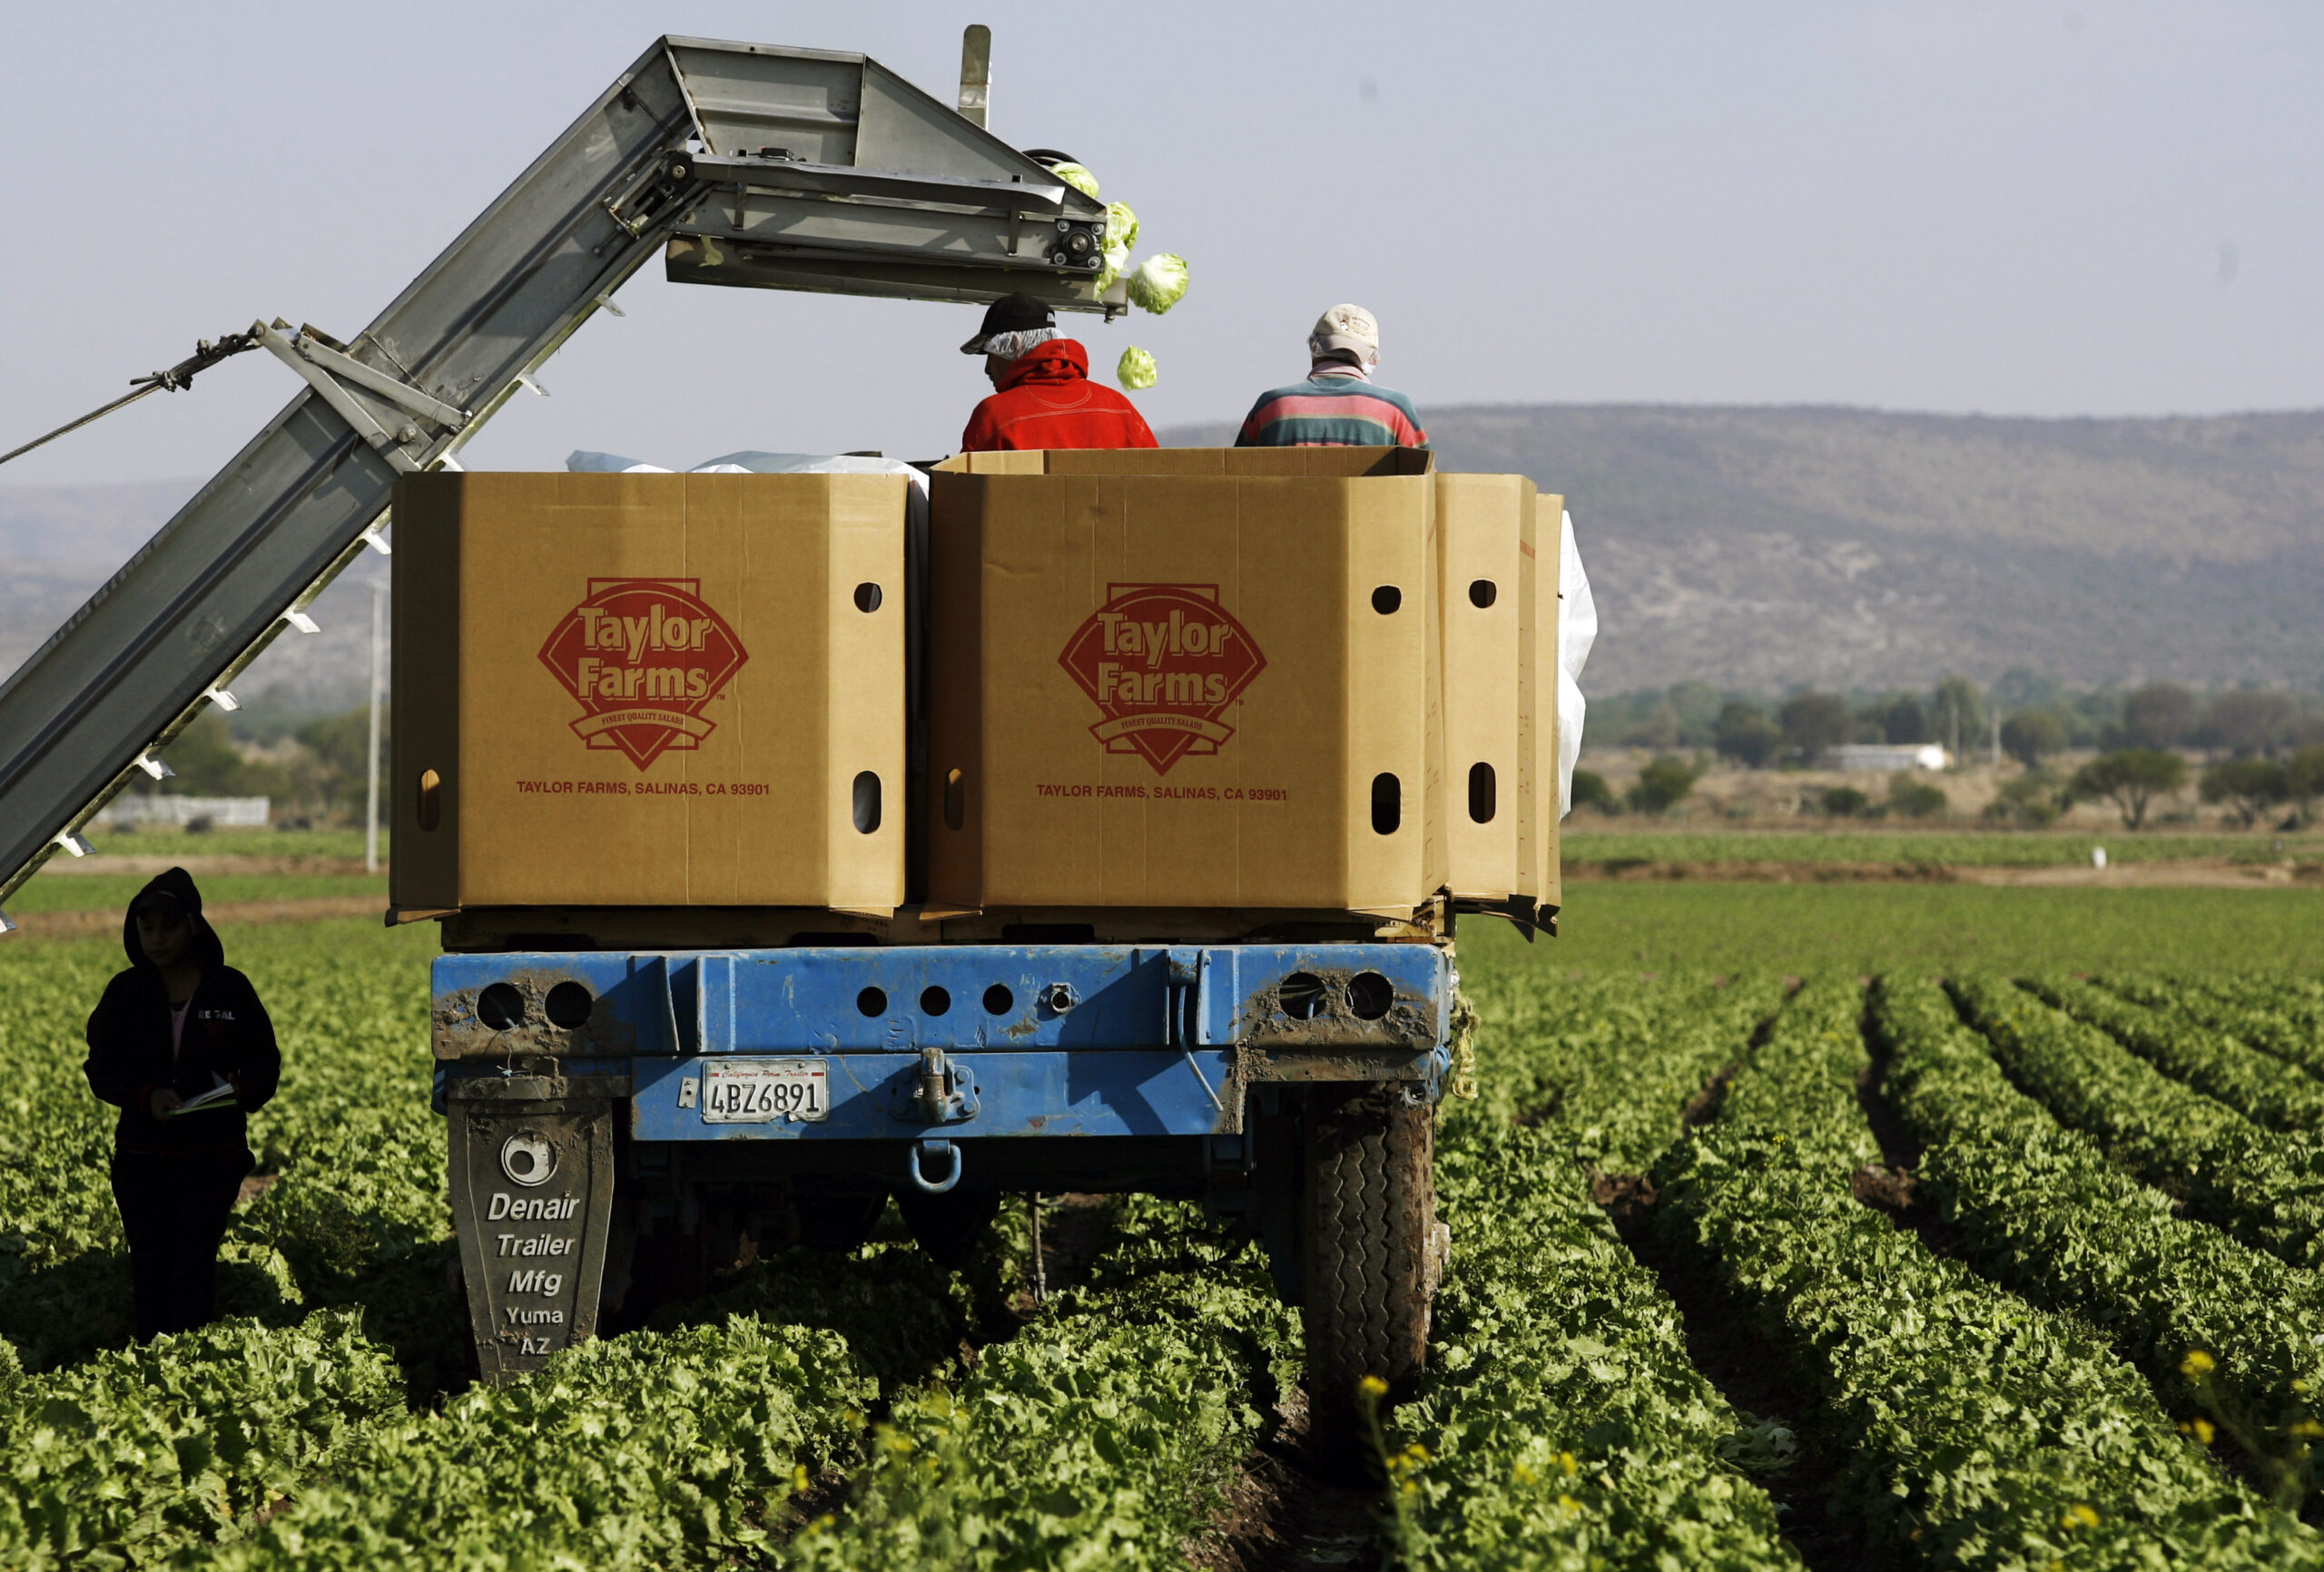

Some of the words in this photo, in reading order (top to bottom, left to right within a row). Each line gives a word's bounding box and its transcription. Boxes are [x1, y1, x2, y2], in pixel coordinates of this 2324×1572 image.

[577, 604, 712, 663] Taylor
[1098, 609, 1232, 669] Taylor
[577, 657, 710, 701] Farms
[1098, 662, 1228, 706] Farms
[602, 713, 625, 724] FINEST
[627, 712, 657, 721] QUALITY
[658, 712, 684, 725] SALADS
[1121, 718, 1145, 729] FINEST
[1147, 716, 1176, 726] QUALITY
[1177, 717, 1203, 730] SALADS
[517, 781, 573, 794] TAYLOR
[577, 781, 631, 796] FARMS,
[635, 782, 702, 796] SALINAS,
[706, 783, 726, 795] CA
[731, 783, 770, 796] 93901
[1036, 784, 1092, 797] TAYLOR
[1097, 785, 1150, 800] FARMS,
[1154, 786, 1220, 801] SALINAS,
[1225, 787, 1245, 800] CA
[1248, 788, 1287, 801] 93901
[722, 1070, 758, 1078] California
[761, 1069, 781, 1077] Perm
[784, 1069, 809, 1077] Trailer
[711, 1083, 820, 1114] 4BZ6891
[487, 1191, 580, 1221] Denair
[497, 1233, 576, 1256] Trailer
[508, 1270, 563, 1297] Mfg
[506, 1306, 564, 1324] Yuma
[520, 1337, 551, 1355] AZ
